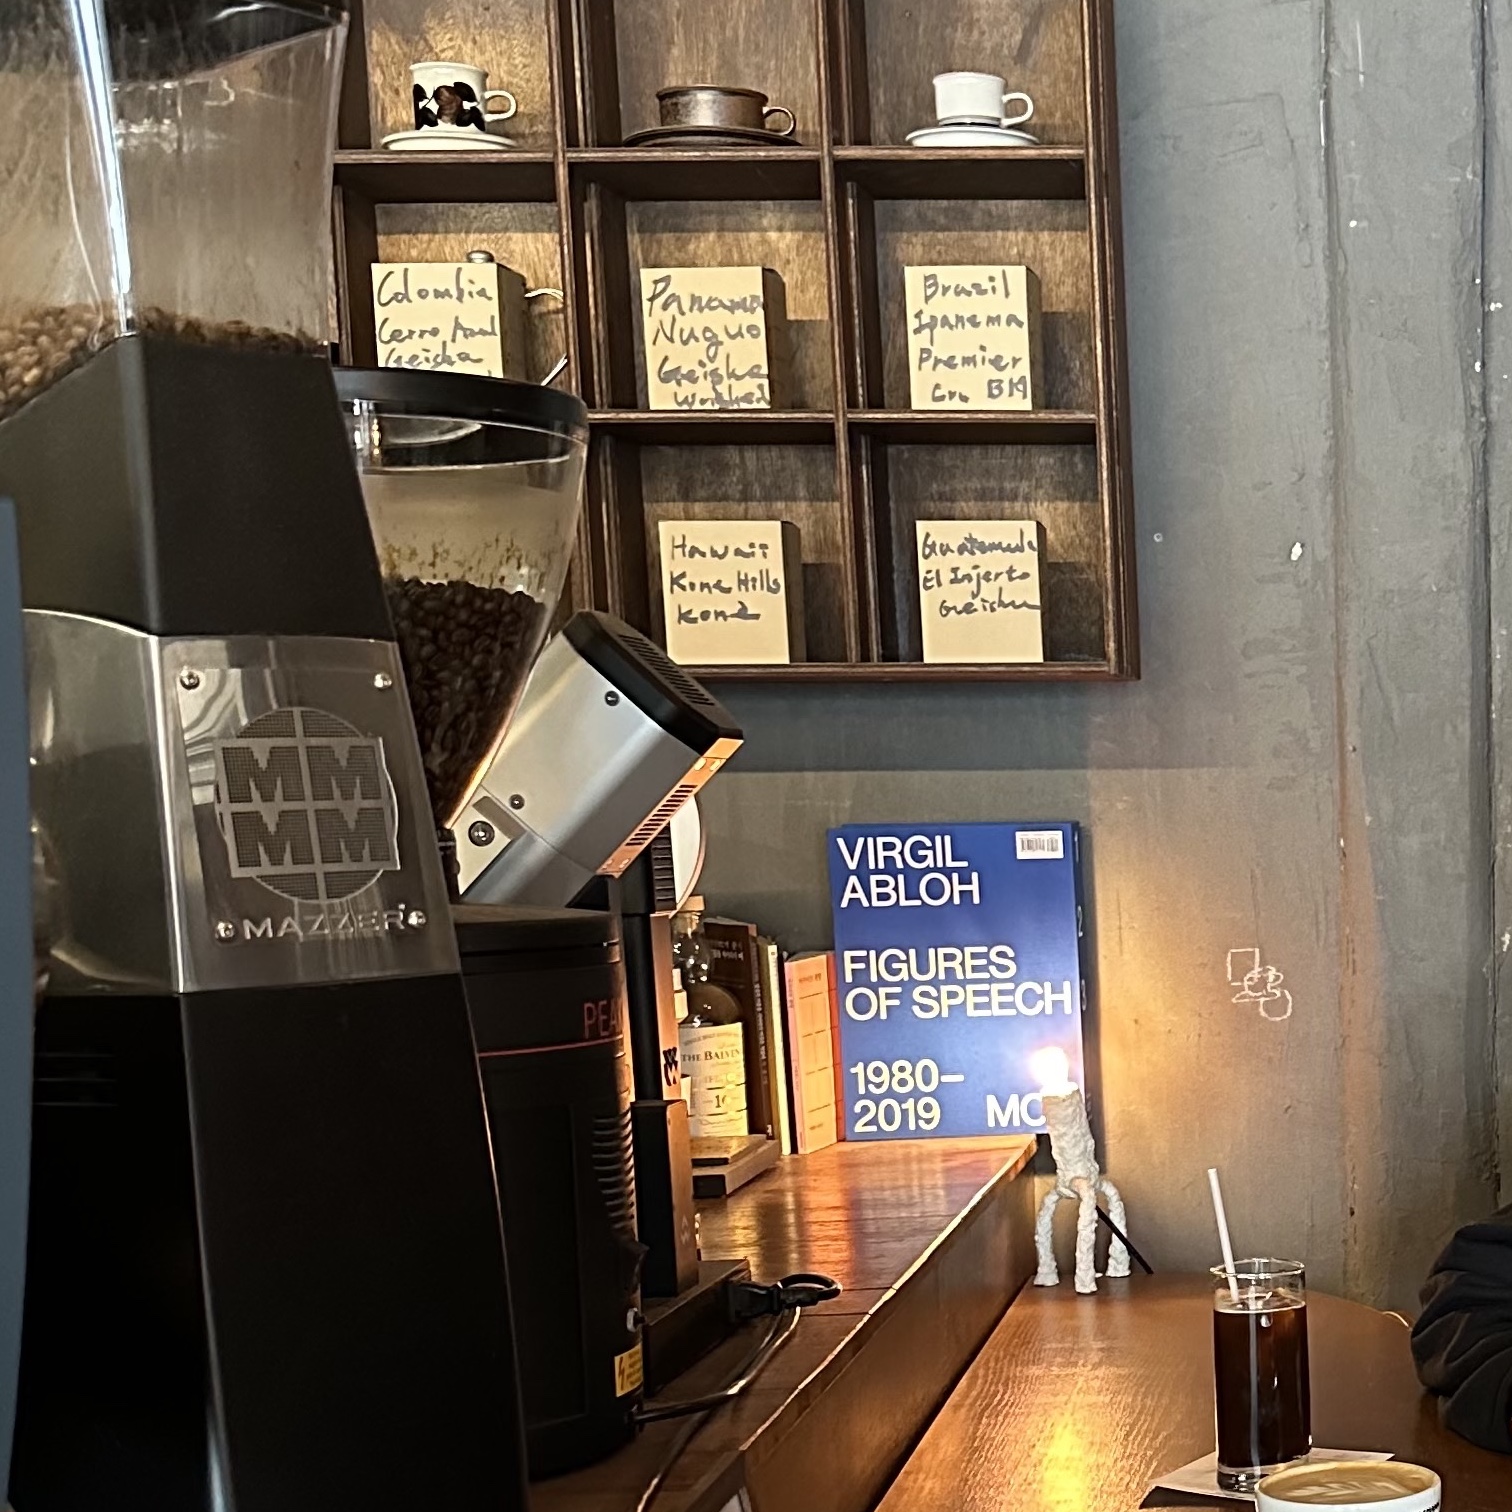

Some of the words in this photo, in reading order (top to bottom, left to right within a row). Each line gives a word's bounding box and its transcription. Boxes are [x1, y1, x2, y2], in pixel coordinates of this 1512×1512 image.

[924, 269, 1010, 305] Brazil
[918, 344, 1022, 372] Premier
[836, 835, 969, 870] VIRGIL
[840, 871, 980, 908] ABLOH
[843, 945, 1018, 983] FIGURES
[845, 986, 903, 1021] OF
[911, 980, 1073, 1020] SPEECH
[853, 1096, 941, 1133] 2019
